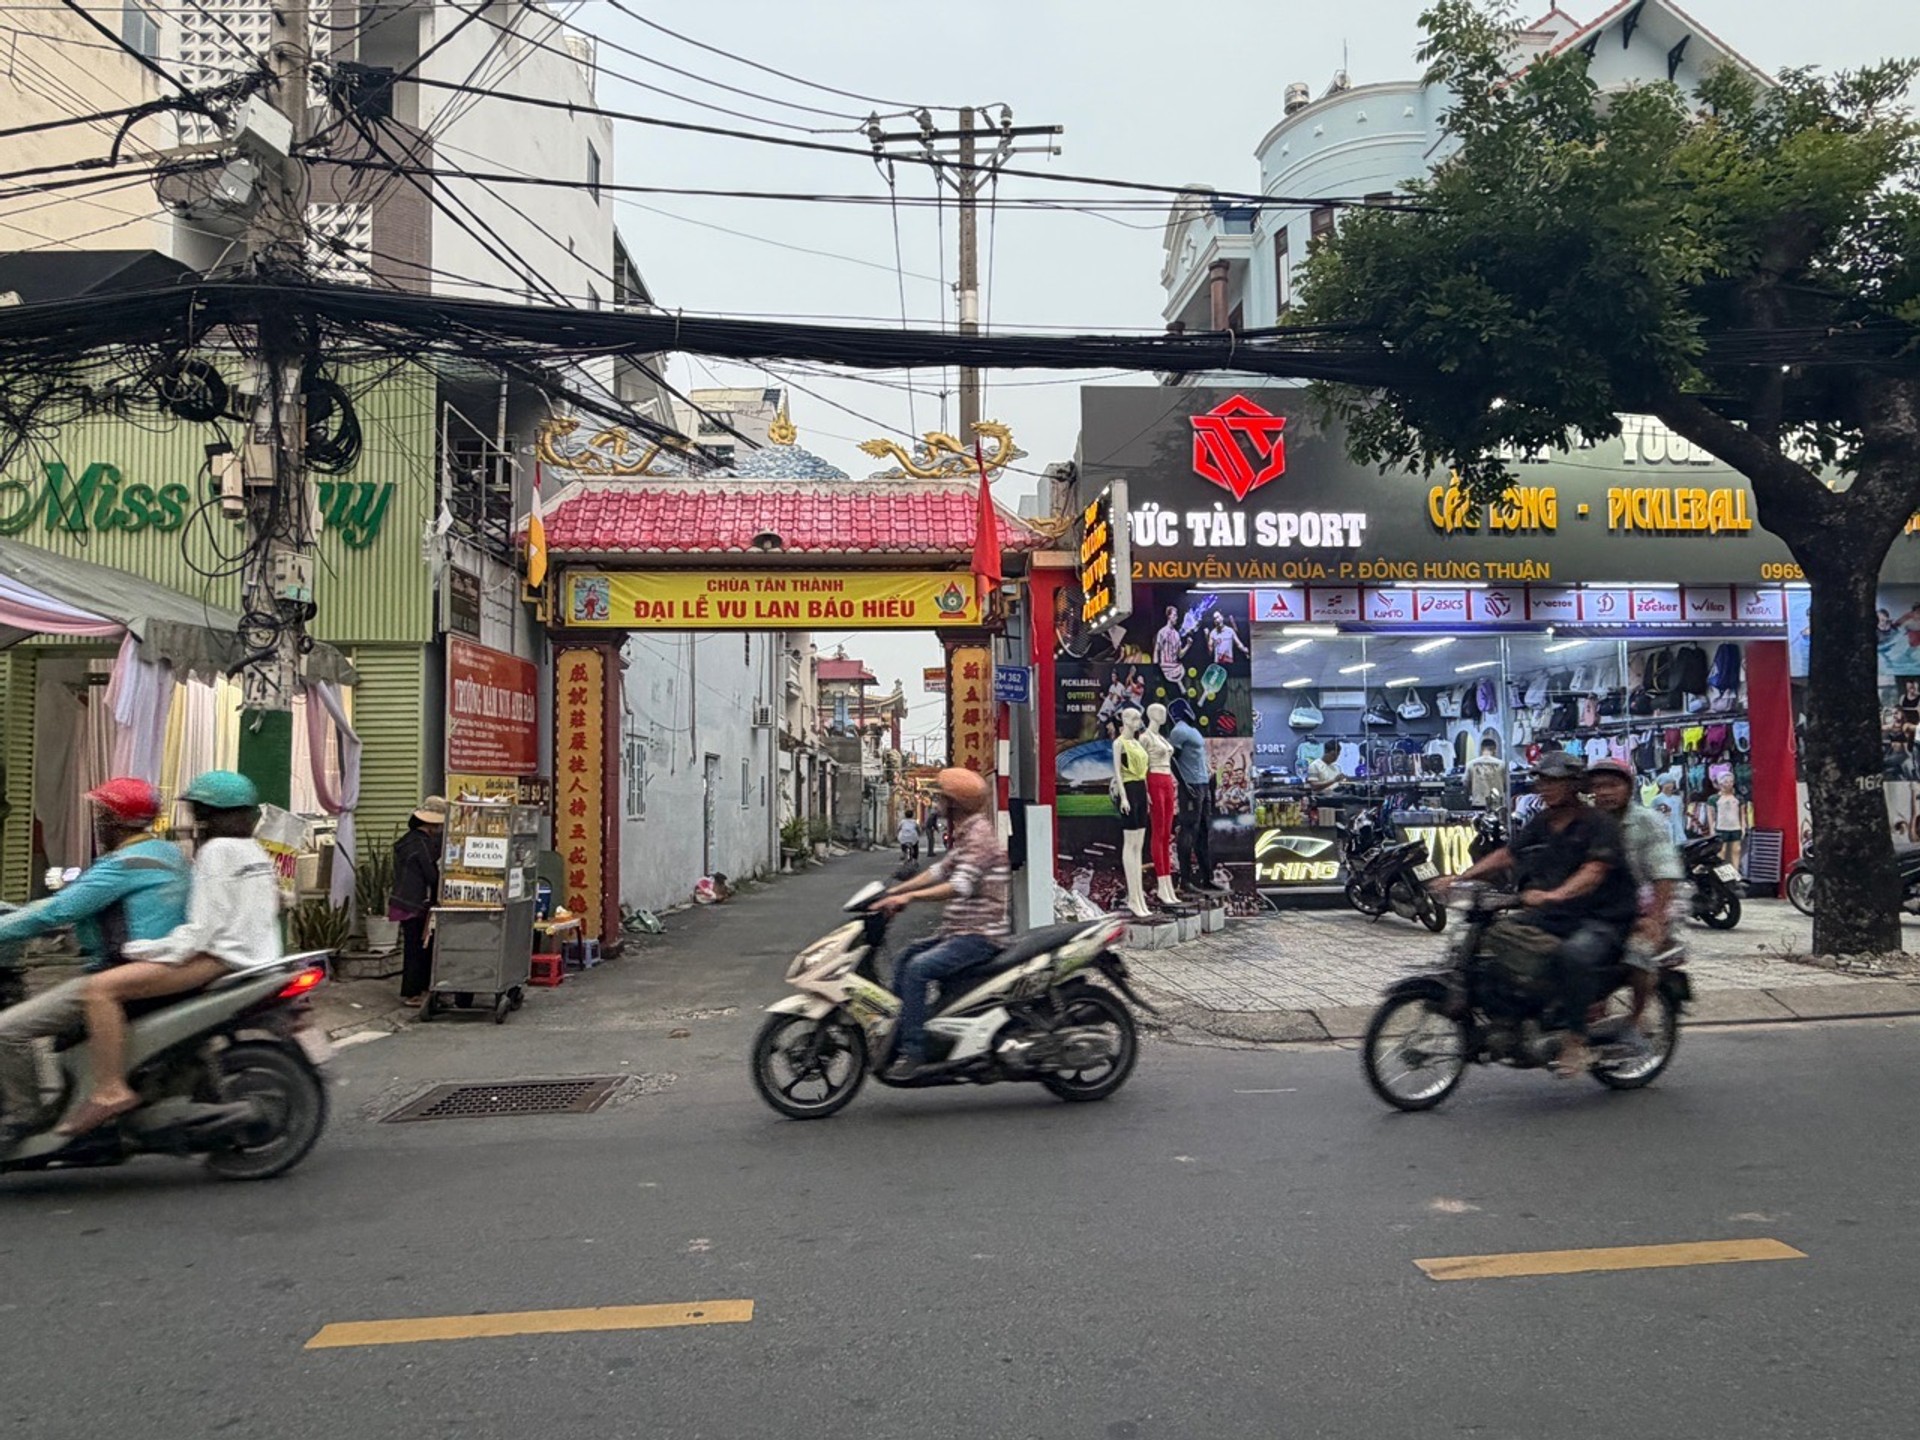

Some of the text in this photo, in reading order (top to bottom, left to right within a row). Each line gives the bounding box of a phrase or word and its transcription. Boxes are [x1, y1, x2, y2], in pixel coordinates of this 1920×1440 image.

[0, 462, 190, 535] Miss
[1607, 486, 1752, 533] PICKLEBALL
[1127, 502, 1178, 547] ỨC
[1186, 502, 1246, 547] TÀI
[1255, 511, 1366, 547] SPORT
[1148, 554, 1231, 578] NGUYỄN
[1235, 559, 1276, 578] VĂN
[1358, 557, 1418, 579] ĐÔNG
[1424, 559, 1481, 579] HƯNG
[1484, 559, 1549, 581] THUẬN
[707, 576, 843, 592] CHÙA TÂN THÀNH
[634, 600, 674, 622] ĐẠI
[682, 594, 709, 618] LỄ
[717, 600, 747, 618] VU
[755, 600, 800, 618] LAN
[808, 596, 855, 618] BÁO
[1067, 704, 1096, 712] FOR MEN
[1256, 743, 1286, 753] SPORT
[1256, 861, 1340, 881] I-NING
